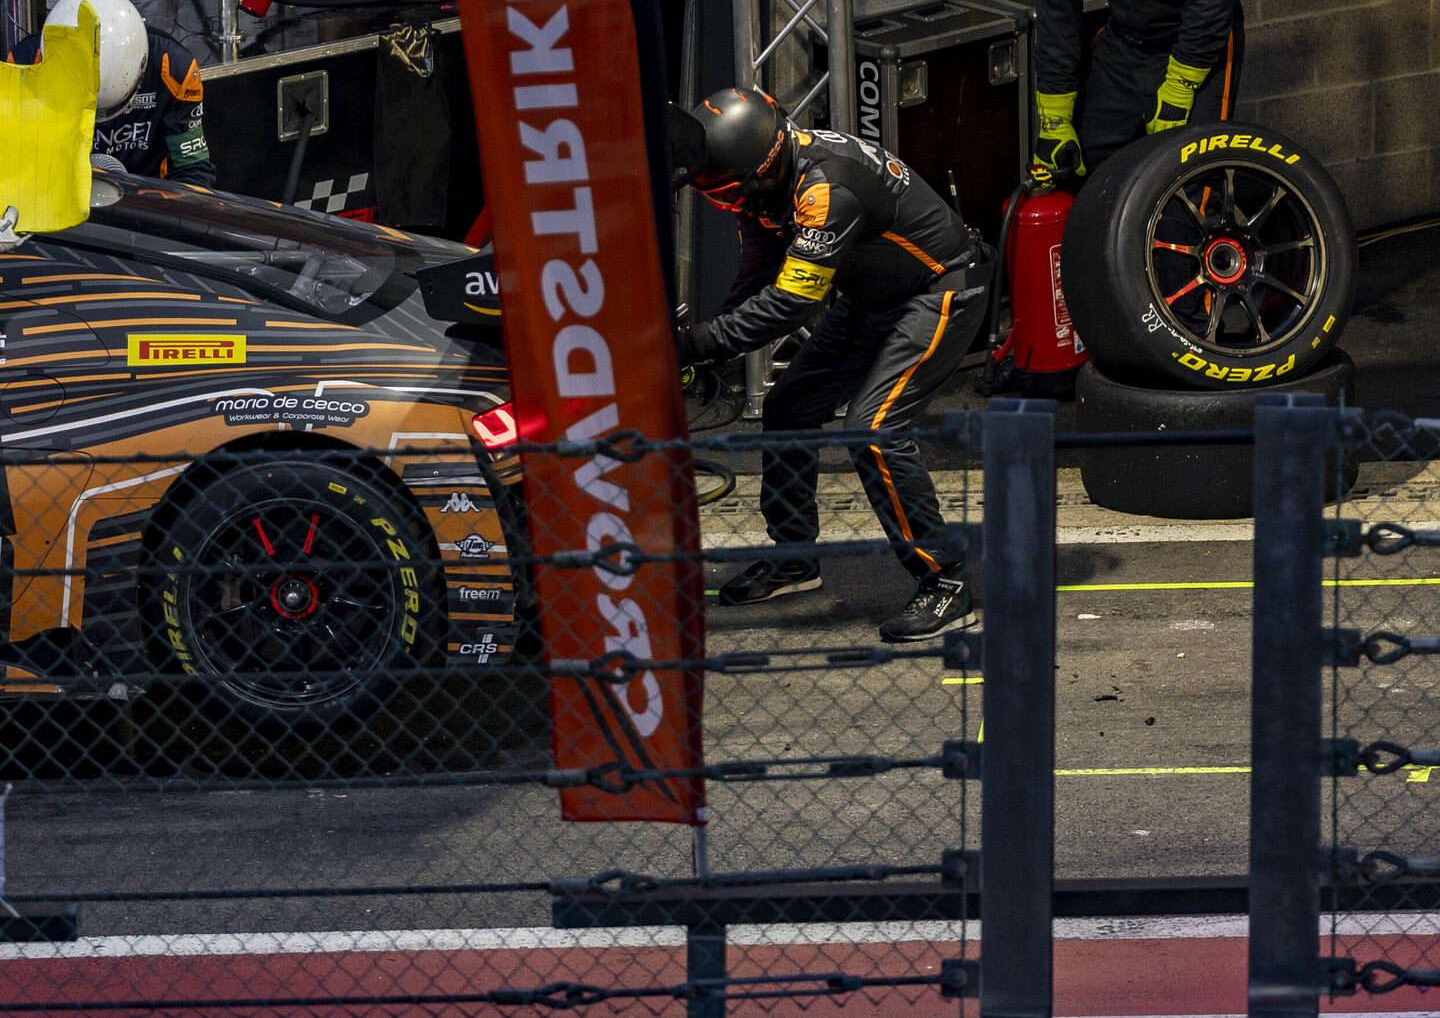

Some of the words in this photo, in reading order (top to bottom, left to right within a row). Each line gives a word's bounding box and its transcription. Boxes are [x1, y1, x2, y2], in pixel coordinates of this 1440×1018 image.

[860, 61, 880, 146] COM
[1181, 134, 1301, 165] PIRELLI
[465, 271, 499, 295] aw
[139, 340, 235, 359] PIRELLI
[1177, 352, 1296, 383] PZERO
[215, 398, 269, 412] mario
[273, 396, 298, 409] de
[302, 398, 365, 414] cecco
[229, 412, 271, 422] Workwear
[282, 412, 325, 421] Corporate
[327, 414, 351, 423] Wear
[459, 586, 501, 600] freem
[459, 643, 498, 654] CRS
